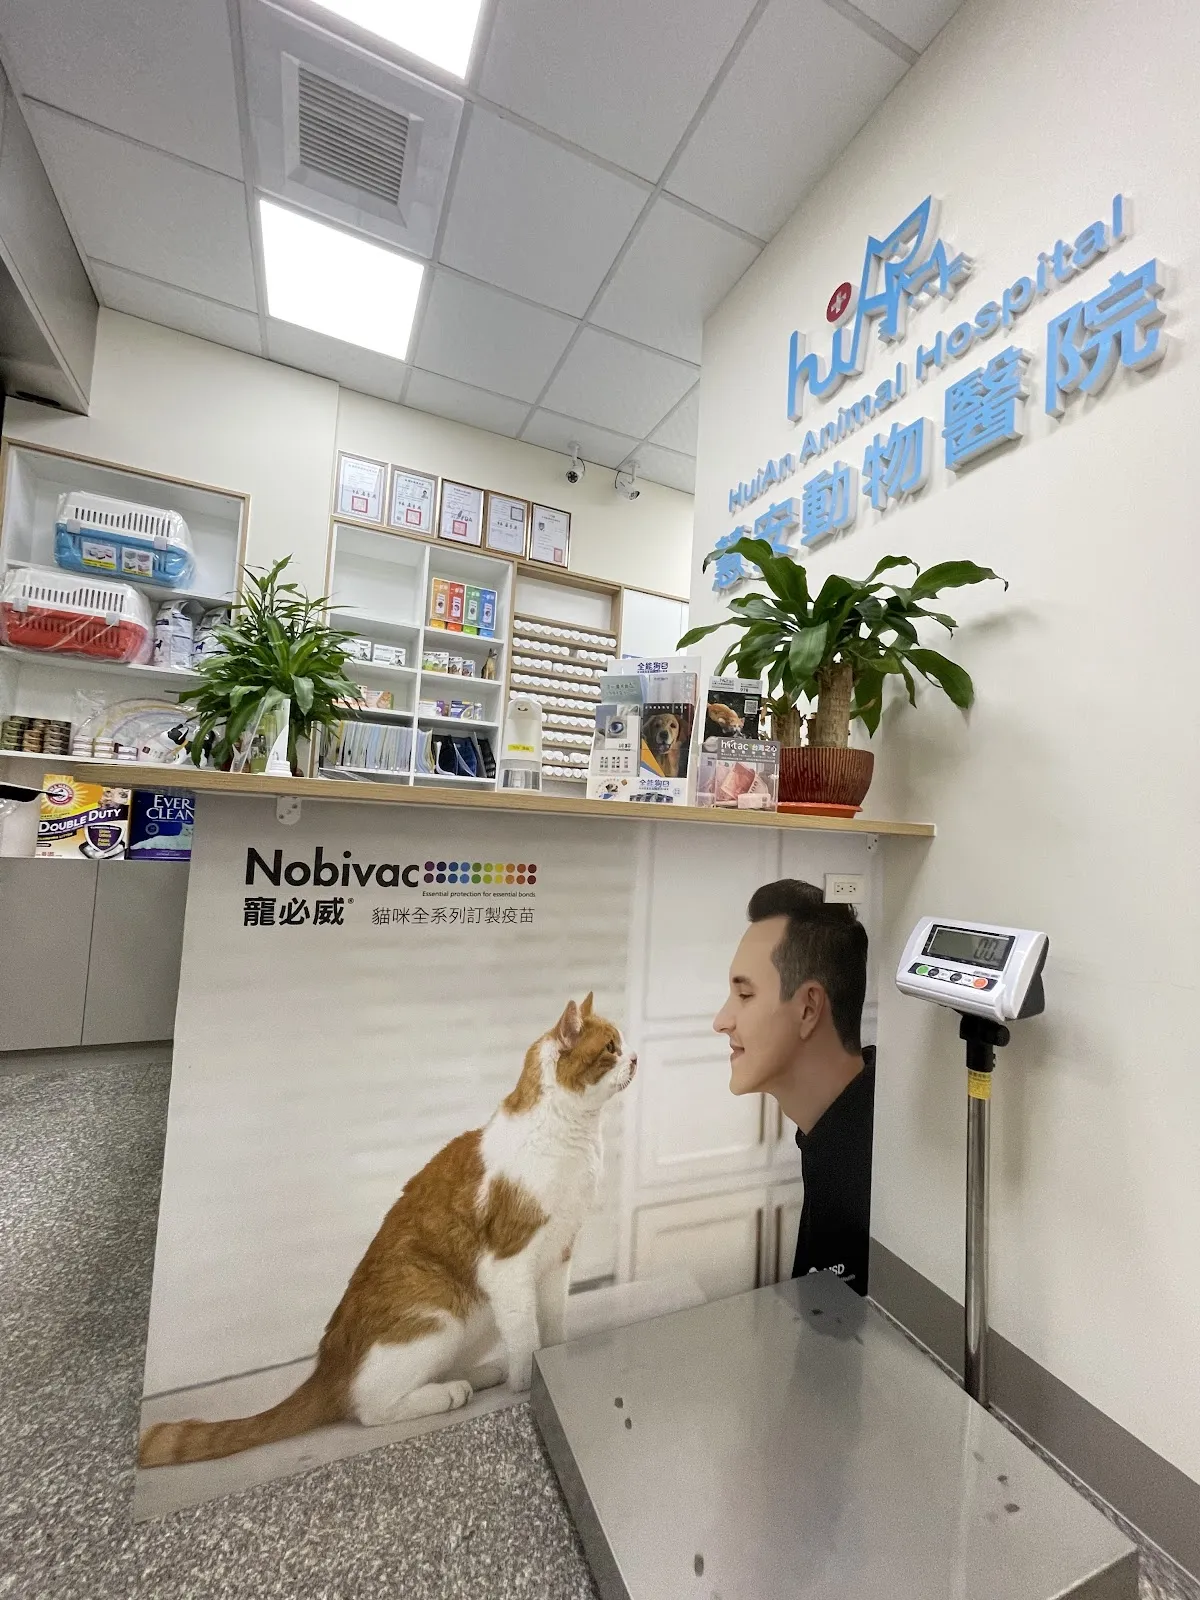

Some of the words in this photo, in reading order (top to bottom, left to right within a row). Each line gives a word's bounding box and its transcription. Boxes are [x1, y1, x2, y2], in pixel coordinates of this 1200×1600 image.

[800, 361, 907, 465] Animal
[916, 192, 1130, 384] Hospital
[153, 794, 194, 810] EVER
[38, 815, 87, 833] DOUBLE
[88, 808, 122, 821] DUTY
[245, 846, 420, 888] Nobivac
[450, 890, 482, 898] protection
[371, 906, 536, 925] 貓咪全系列訂製疫苗
